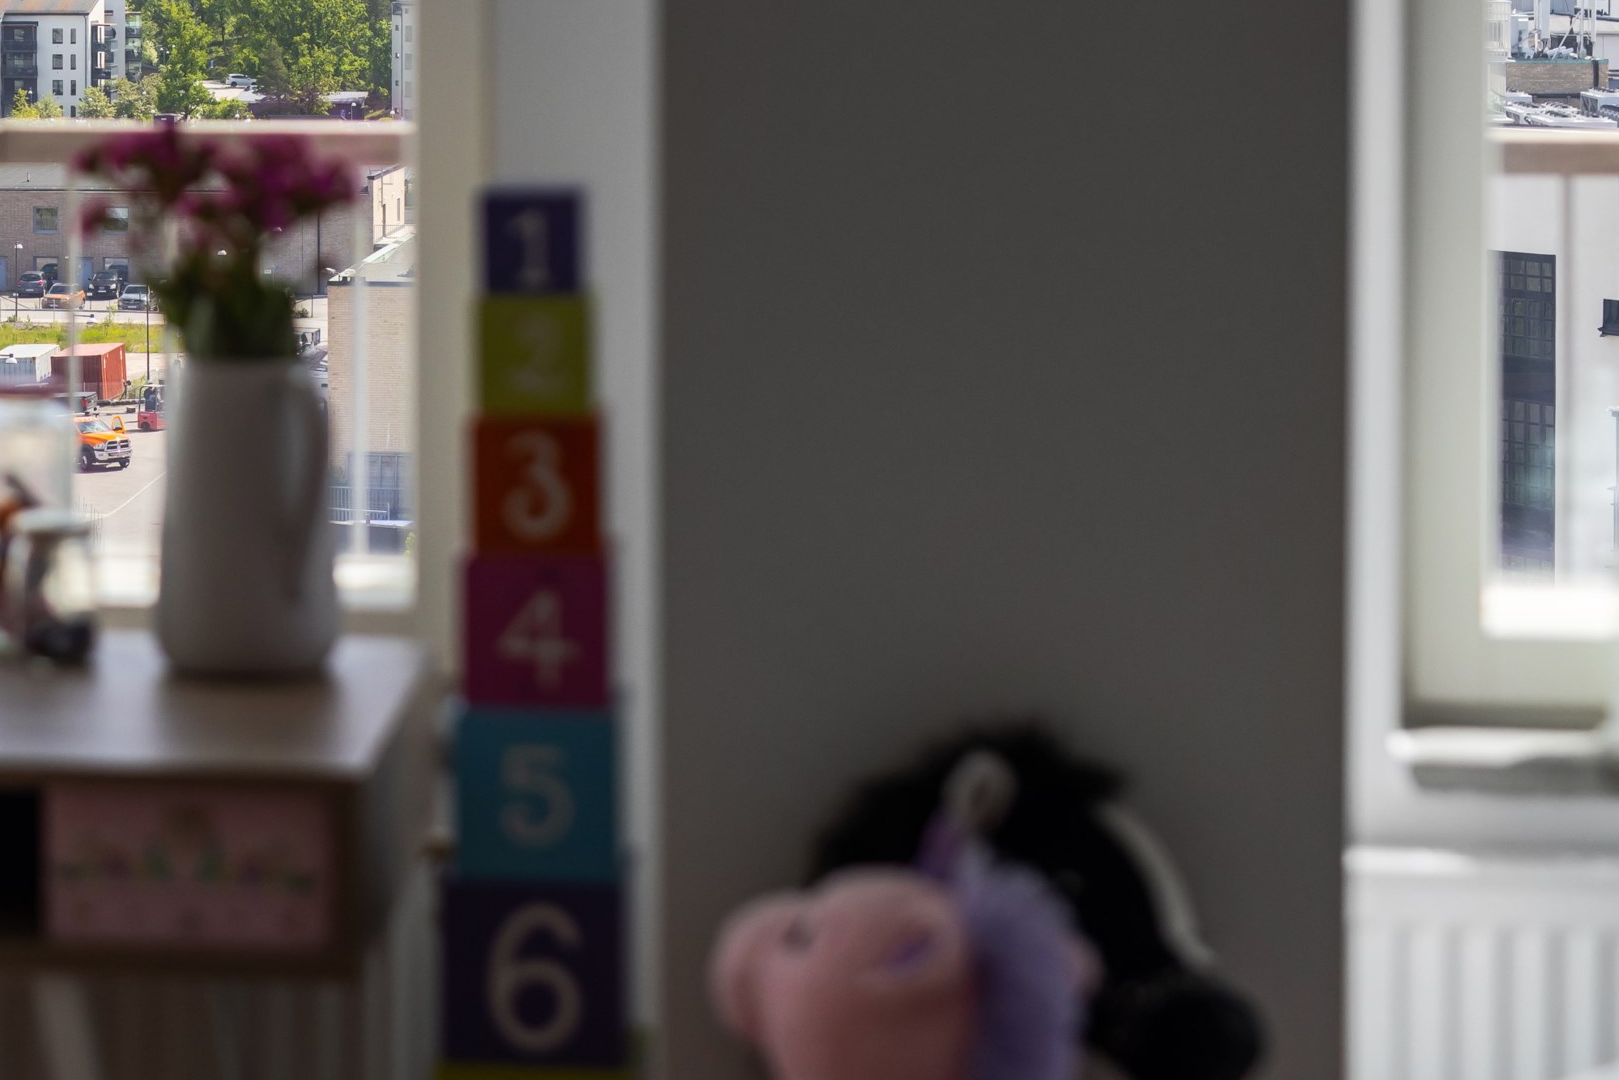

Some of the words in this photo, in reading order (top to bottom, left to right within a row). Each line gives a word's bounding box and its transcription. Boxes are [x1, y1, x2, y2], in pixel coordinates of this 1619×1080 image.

[506, 209, 548, 287] 1
[503, 311, 568, 397] 2
[503, 430, 573, 540] 3
[497, 588, 581, 696] 4
[499, 743, 576, 852] 5
[488, 900, 584, 1054] 6
